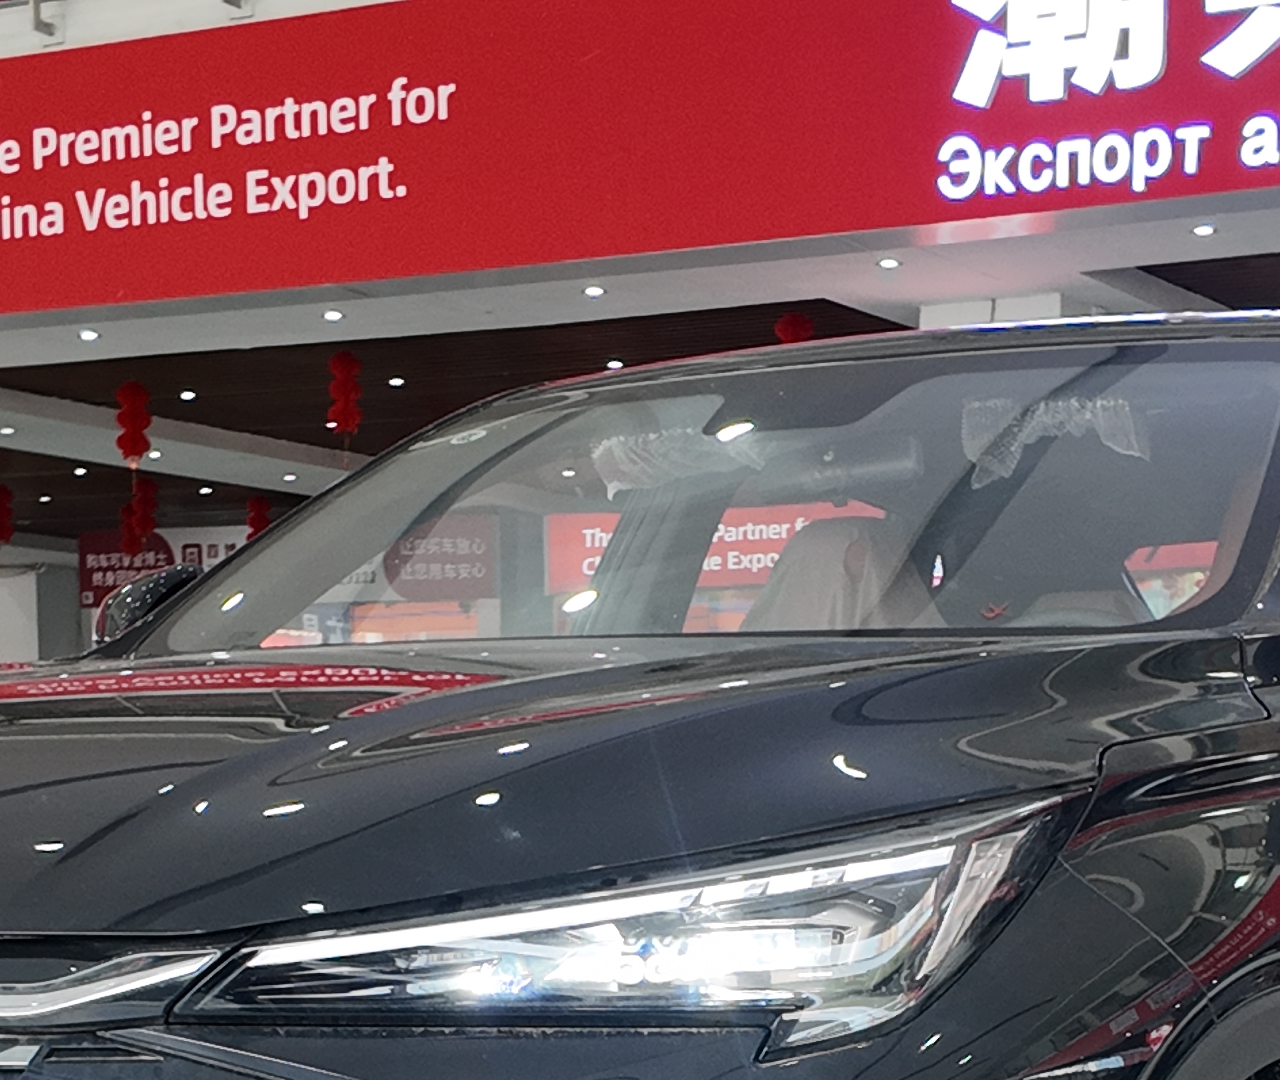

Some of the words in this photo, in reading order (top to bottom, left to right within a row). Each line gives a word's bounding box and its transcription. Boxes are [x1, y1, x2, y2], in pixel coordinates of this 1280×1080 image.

[32, 110, 198, 170] Premier
[210, 94, 376, 150] Partner
[388, 76, 456, 126] for
[75, 173, 232, 231] Vehicle
[246, 157, 408, 219] Export.
[937, 126, 1210, 200] Экспорт
